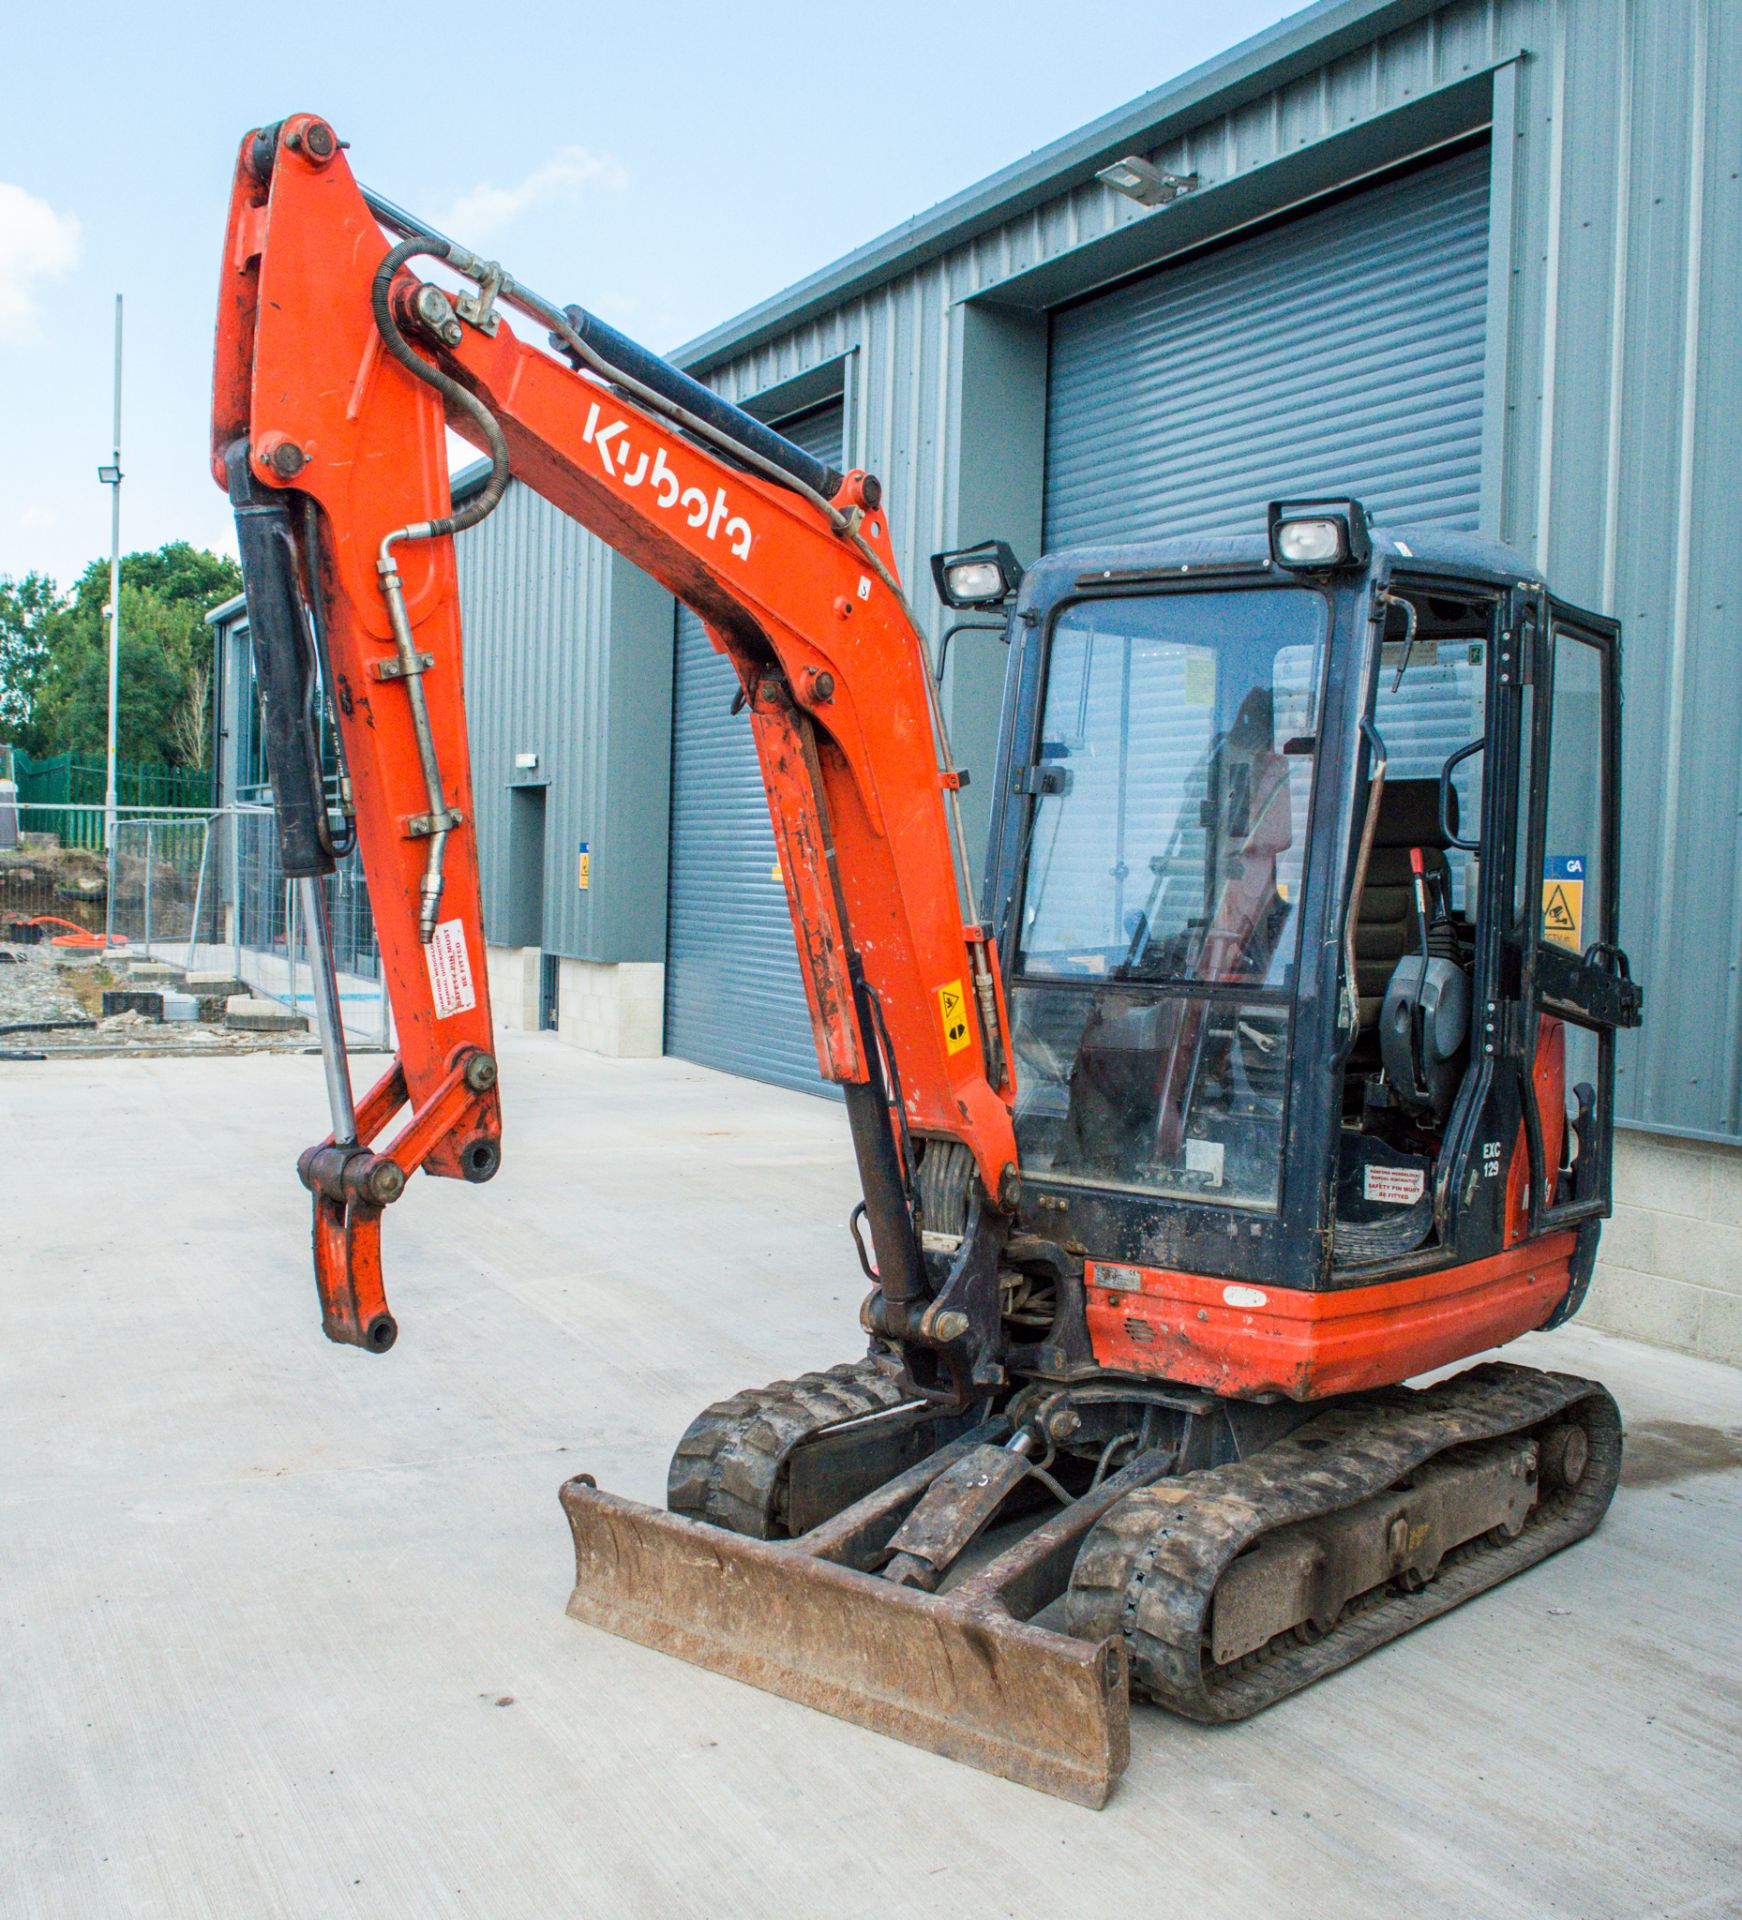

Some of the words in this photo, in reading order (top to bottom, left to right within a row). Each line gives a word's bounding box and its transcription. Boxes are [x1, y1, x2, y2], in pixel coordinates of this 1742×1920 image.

[582, 402, 753, 562] Kubota
[1566, 860, 1583, 872] GA
[443, 928, 453, 954] MUST
[448, 955, 456, 971] PIN
[455, 941, 465, 974] FITTED
[451, 973, 462, 1008] SAFETY
[461, 976, 468, 987] BE
[1483, 1141, 1501, 1159] EXC
[1484, 1160, 1499, 1178] 129
